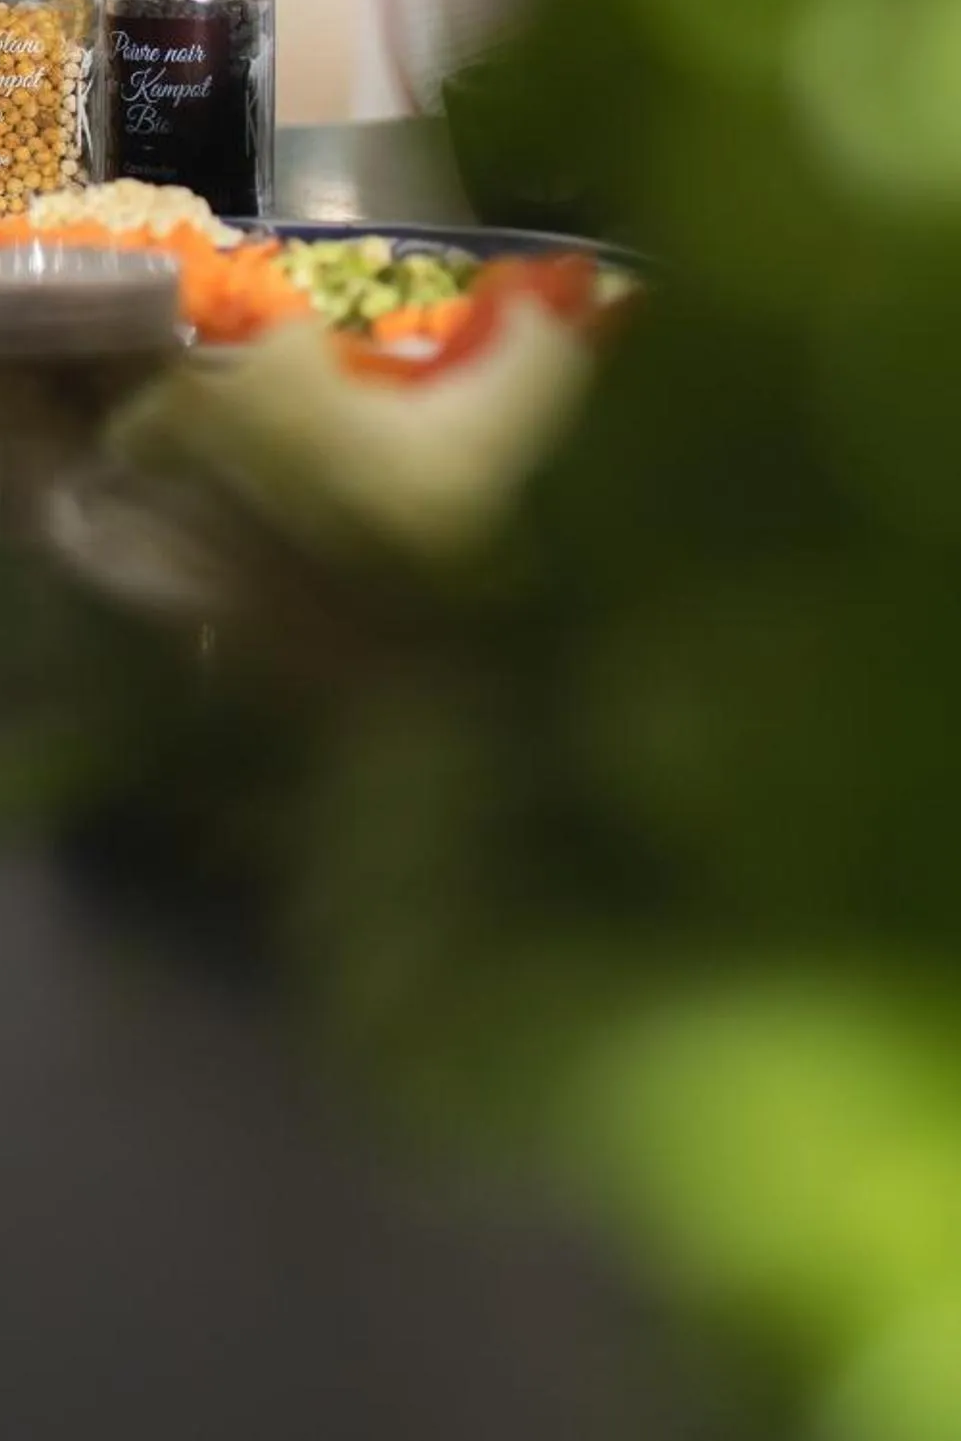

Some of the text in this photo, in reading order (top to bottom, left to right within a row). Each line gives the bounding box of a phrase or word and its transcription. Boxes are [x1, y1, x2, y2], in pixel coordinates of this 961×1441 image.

[111, 30, 206, 63] Poivre noir
[120, 66, 213, 108] Kampot
